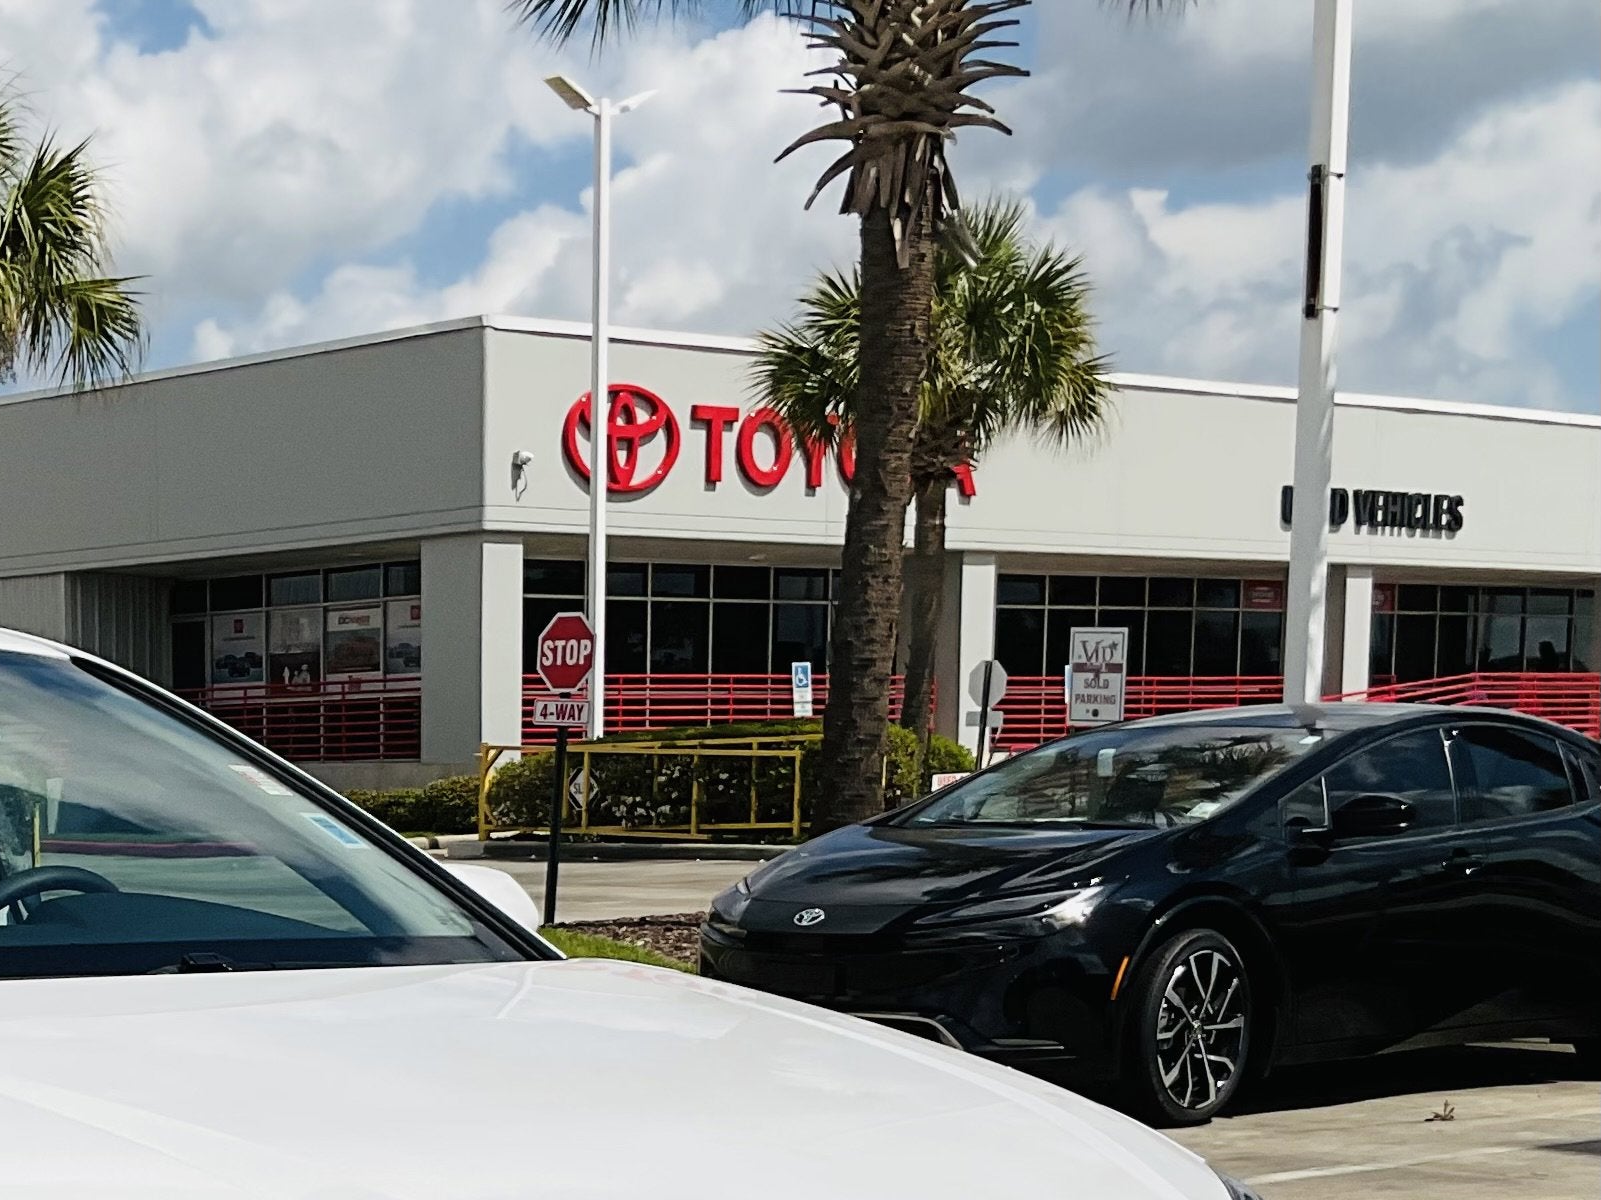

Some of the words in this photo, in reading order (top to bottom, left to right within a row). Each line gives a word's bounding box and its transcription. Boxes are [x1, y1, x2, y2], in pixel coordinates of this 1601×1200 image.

[1353, 489, 1464, 532] VEHICLES
[542, 639, 592, 667] STOP
[1083, 678, 1110, 689] SOLD
[1074, 693, 1116, 705] PARKING
[539, 703, 584, 721] 4-WAY
